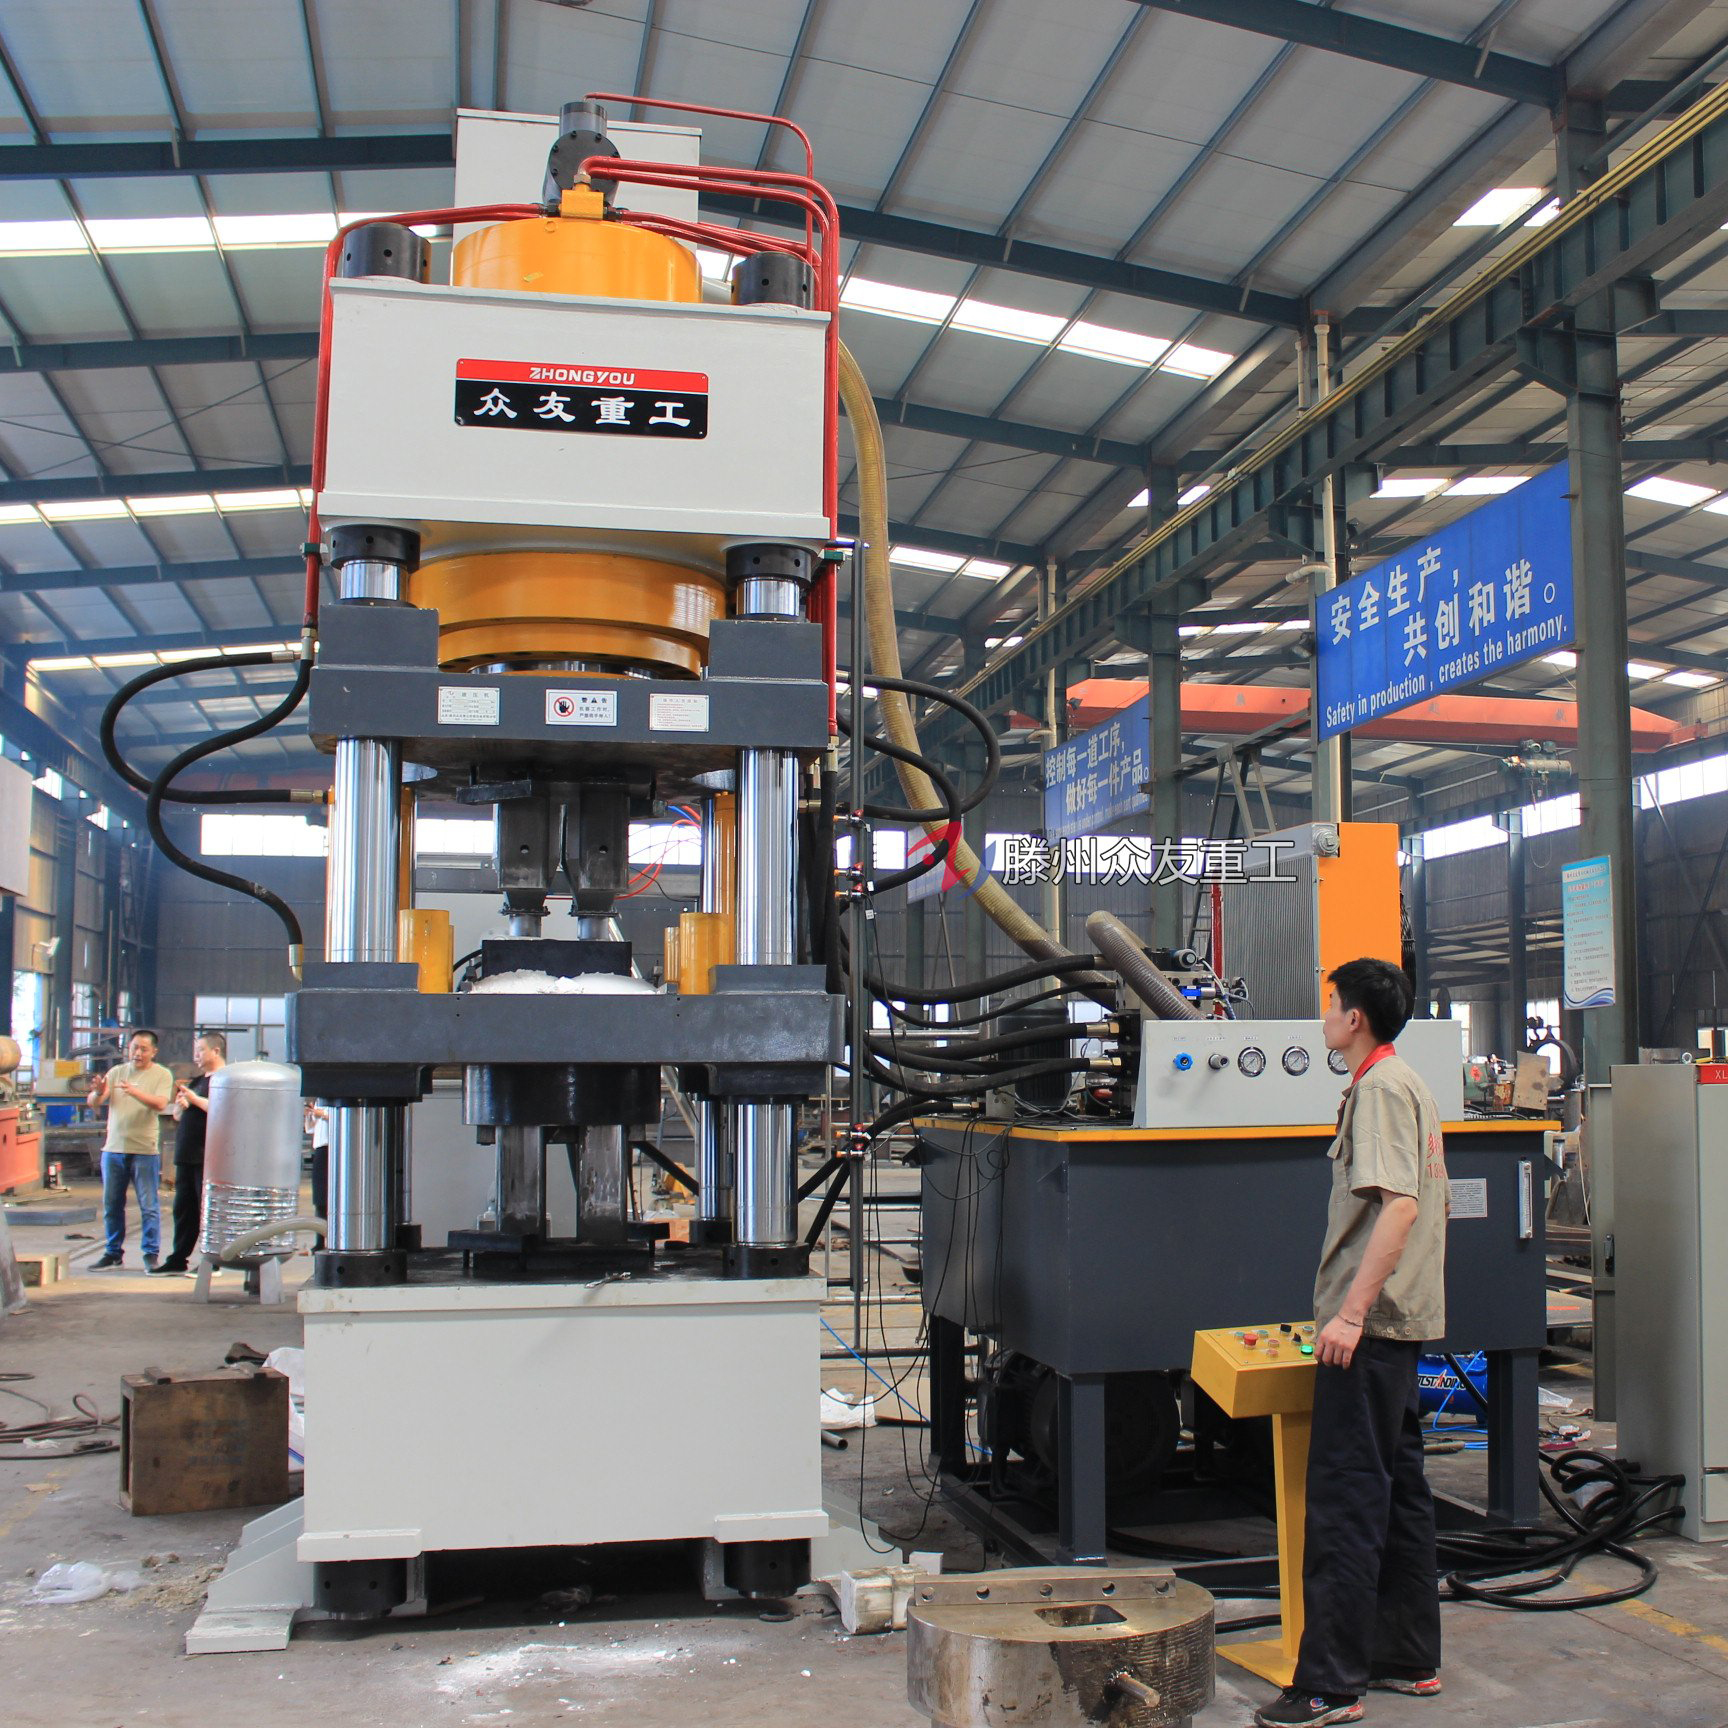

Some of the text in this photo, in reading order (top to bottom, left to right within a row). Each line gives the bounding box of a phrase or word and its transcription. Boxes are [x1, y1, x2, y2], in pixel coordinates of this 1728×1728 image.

[529, 367, 635, 385] ZHONGYOU
[473, 387, 691, 427] 众友重工
[1326, 702, 1355, 728] Safety
[1358, 694, 1368, 716] in
[1439, 650, 1480, 683] creates
[1483, 639, 1503, 665] the
[1507, 614, 1567, 655] harmony.
